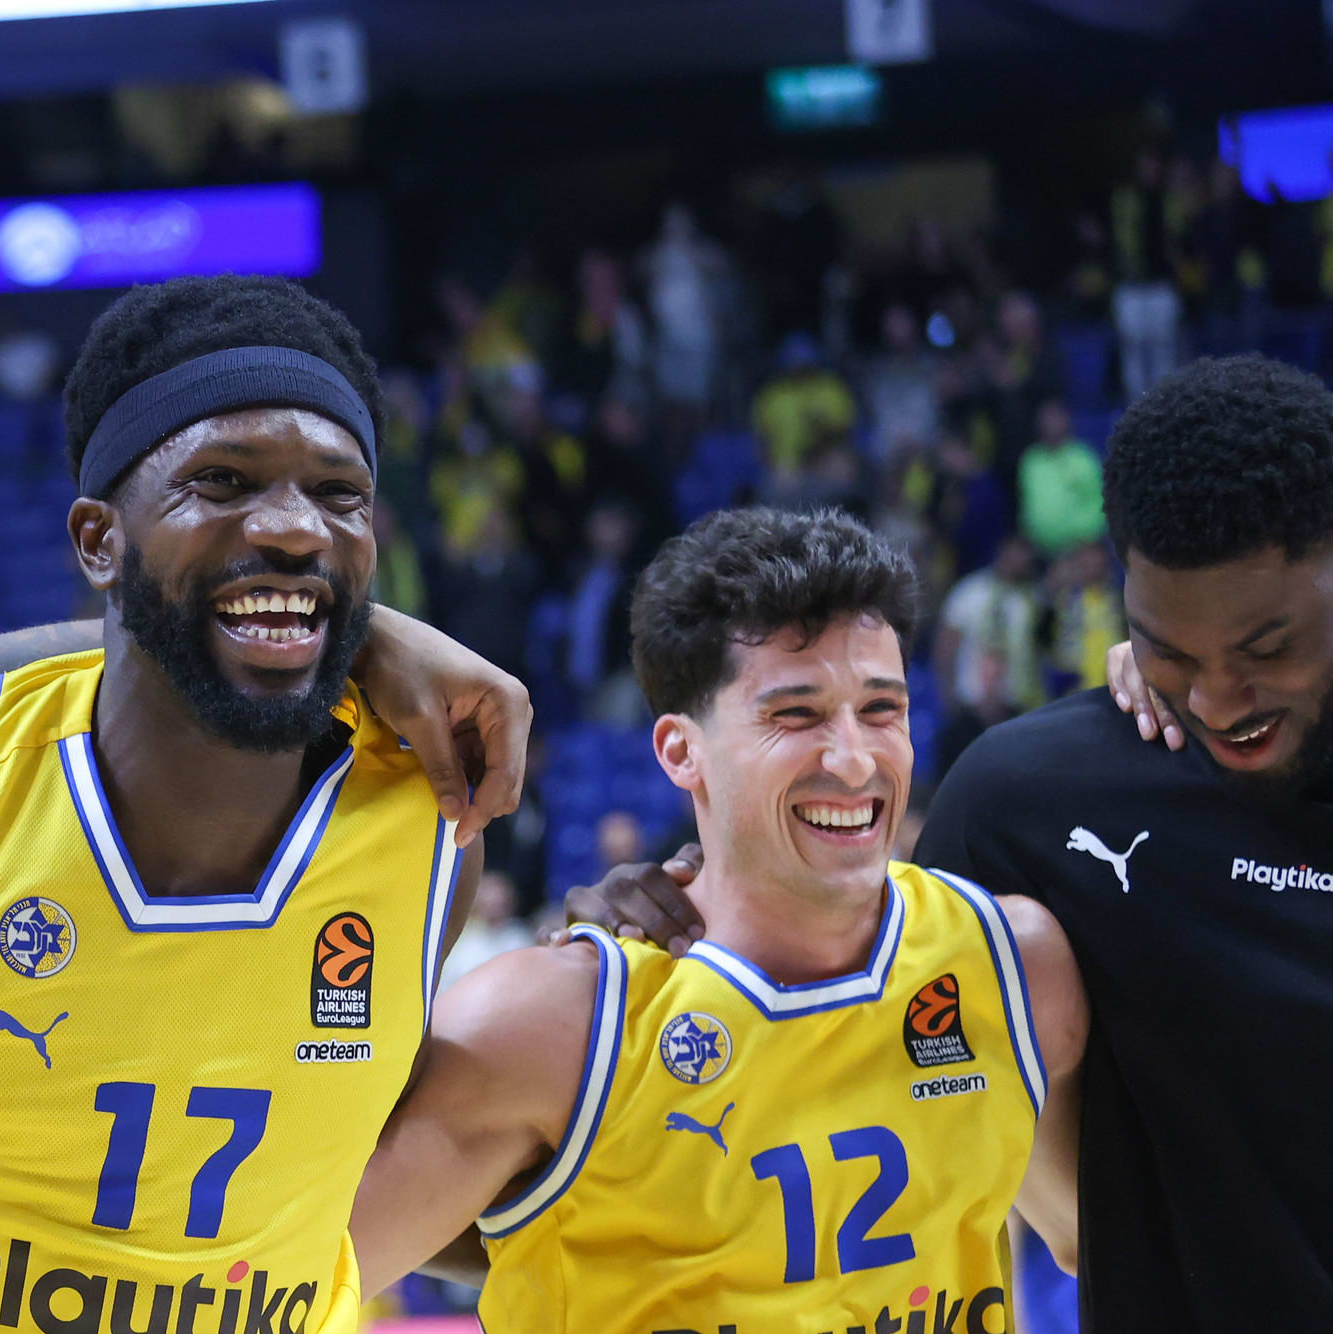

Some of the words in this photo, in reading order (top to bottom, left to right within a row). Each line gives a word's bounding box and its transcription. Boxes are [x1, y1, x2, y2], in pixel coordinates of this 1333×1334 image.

[1231, 857, 1333, 892] Playtika
[317, 989, 366, 1001] TURKISH
[316, 1001, 366, 1013] AIRLINES
[316, 1013, 366, 1026] EuroLeague
[297, 1041, 370, 1060] oneteam
[911, 1035, 961, 1050] TURKISH
[912, 1076, 985, 1099] oneteam
[91, 1081, 272, 1239] 17
[750, 1125, 916, 1284] 12
